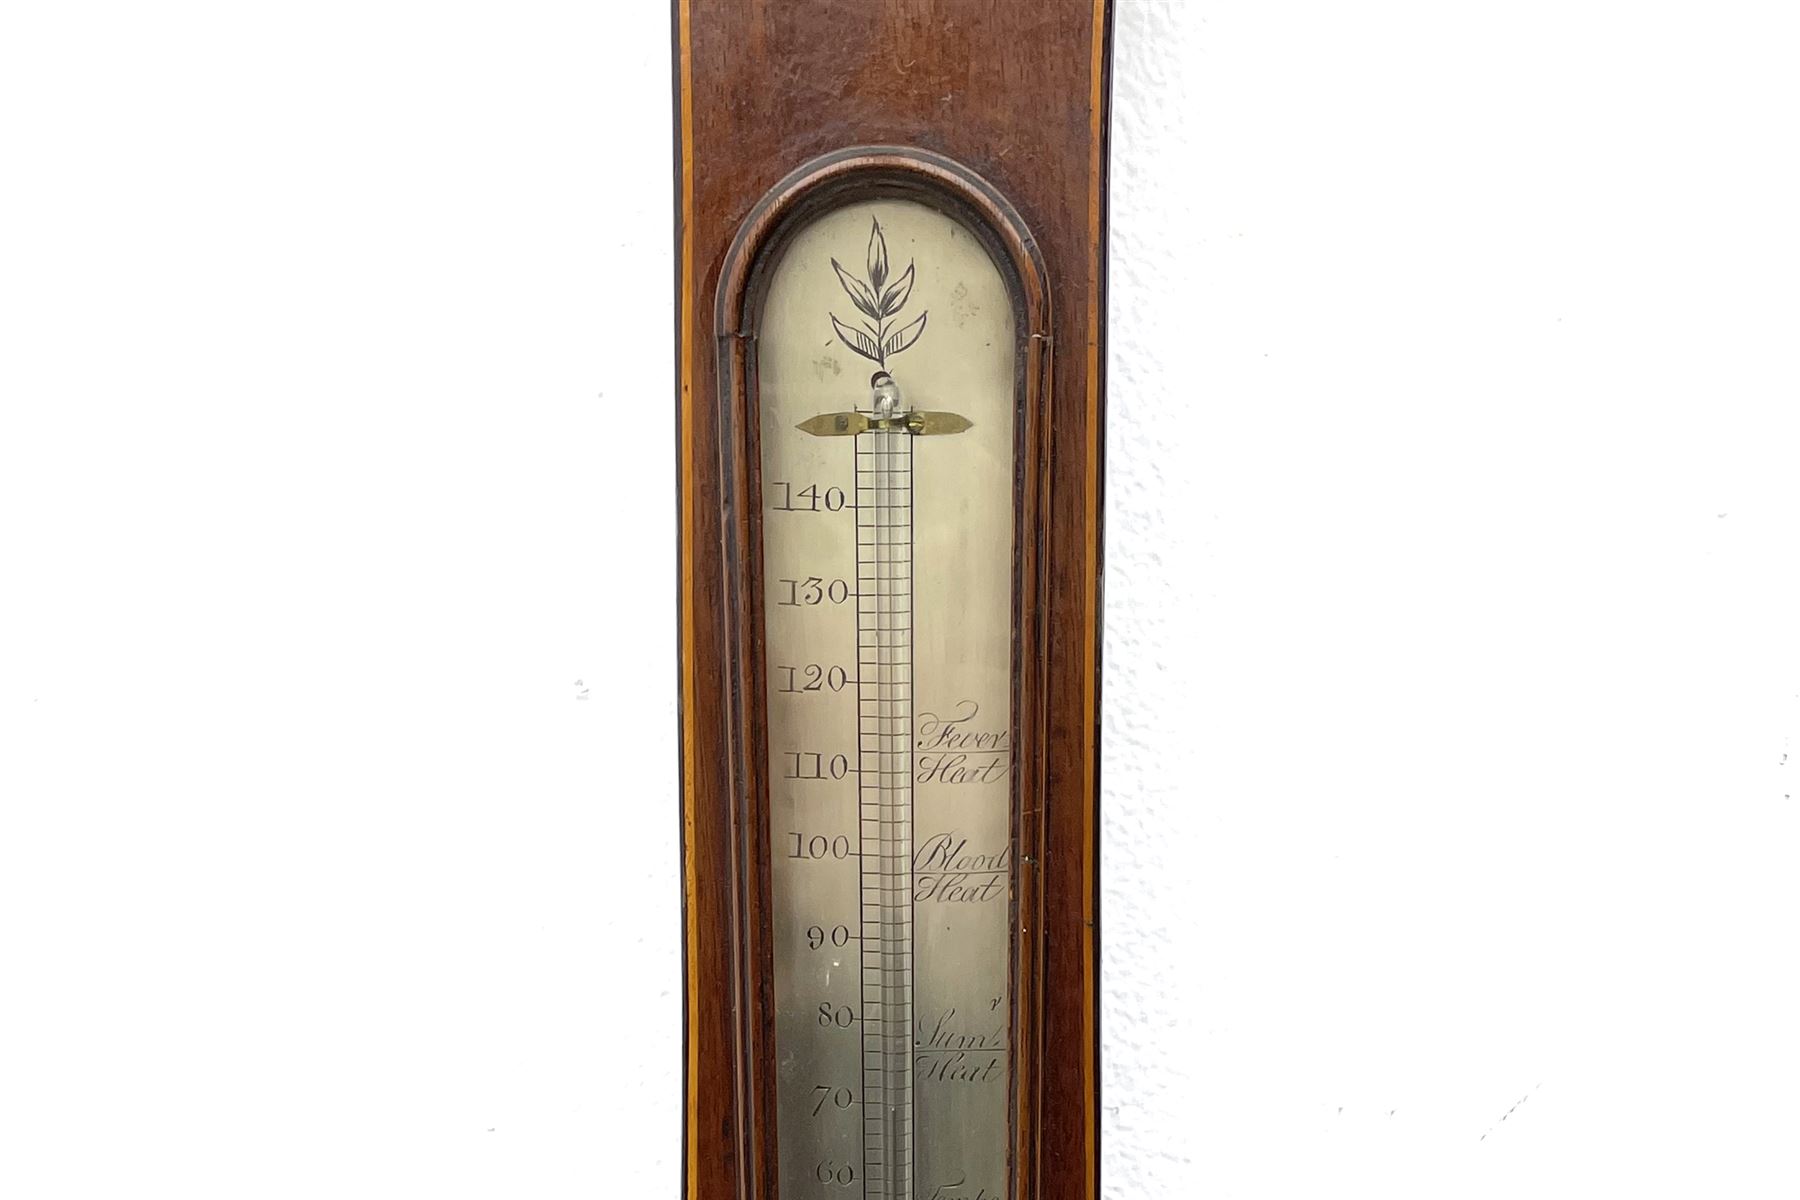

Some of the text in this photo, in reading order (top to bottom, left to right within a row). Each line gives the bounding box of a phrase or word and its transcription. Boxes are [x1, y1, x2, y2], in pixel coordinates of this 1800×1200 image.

[772, 482, 845, 512] 140
[777, 576, 848, 606] 130
[777, 663, 847, 693] 120
[917, 699, 1008, 751] Fever
[783, 752, 848, 780] 110
[916, 753, 1009, 784] Heat
[787, 832, 849, 859] 100
[912, 830, 1009, 872] Blood
[914, 873, 1006, 902] Heat
[806, 924, 849, 950] 90
[818, 1001, 854, 1028] 80
[915, 1052, 1004, 1082] Heat
[810, 1085, 852, 1117] 70
[816, 1160, 854, 1187] 60
